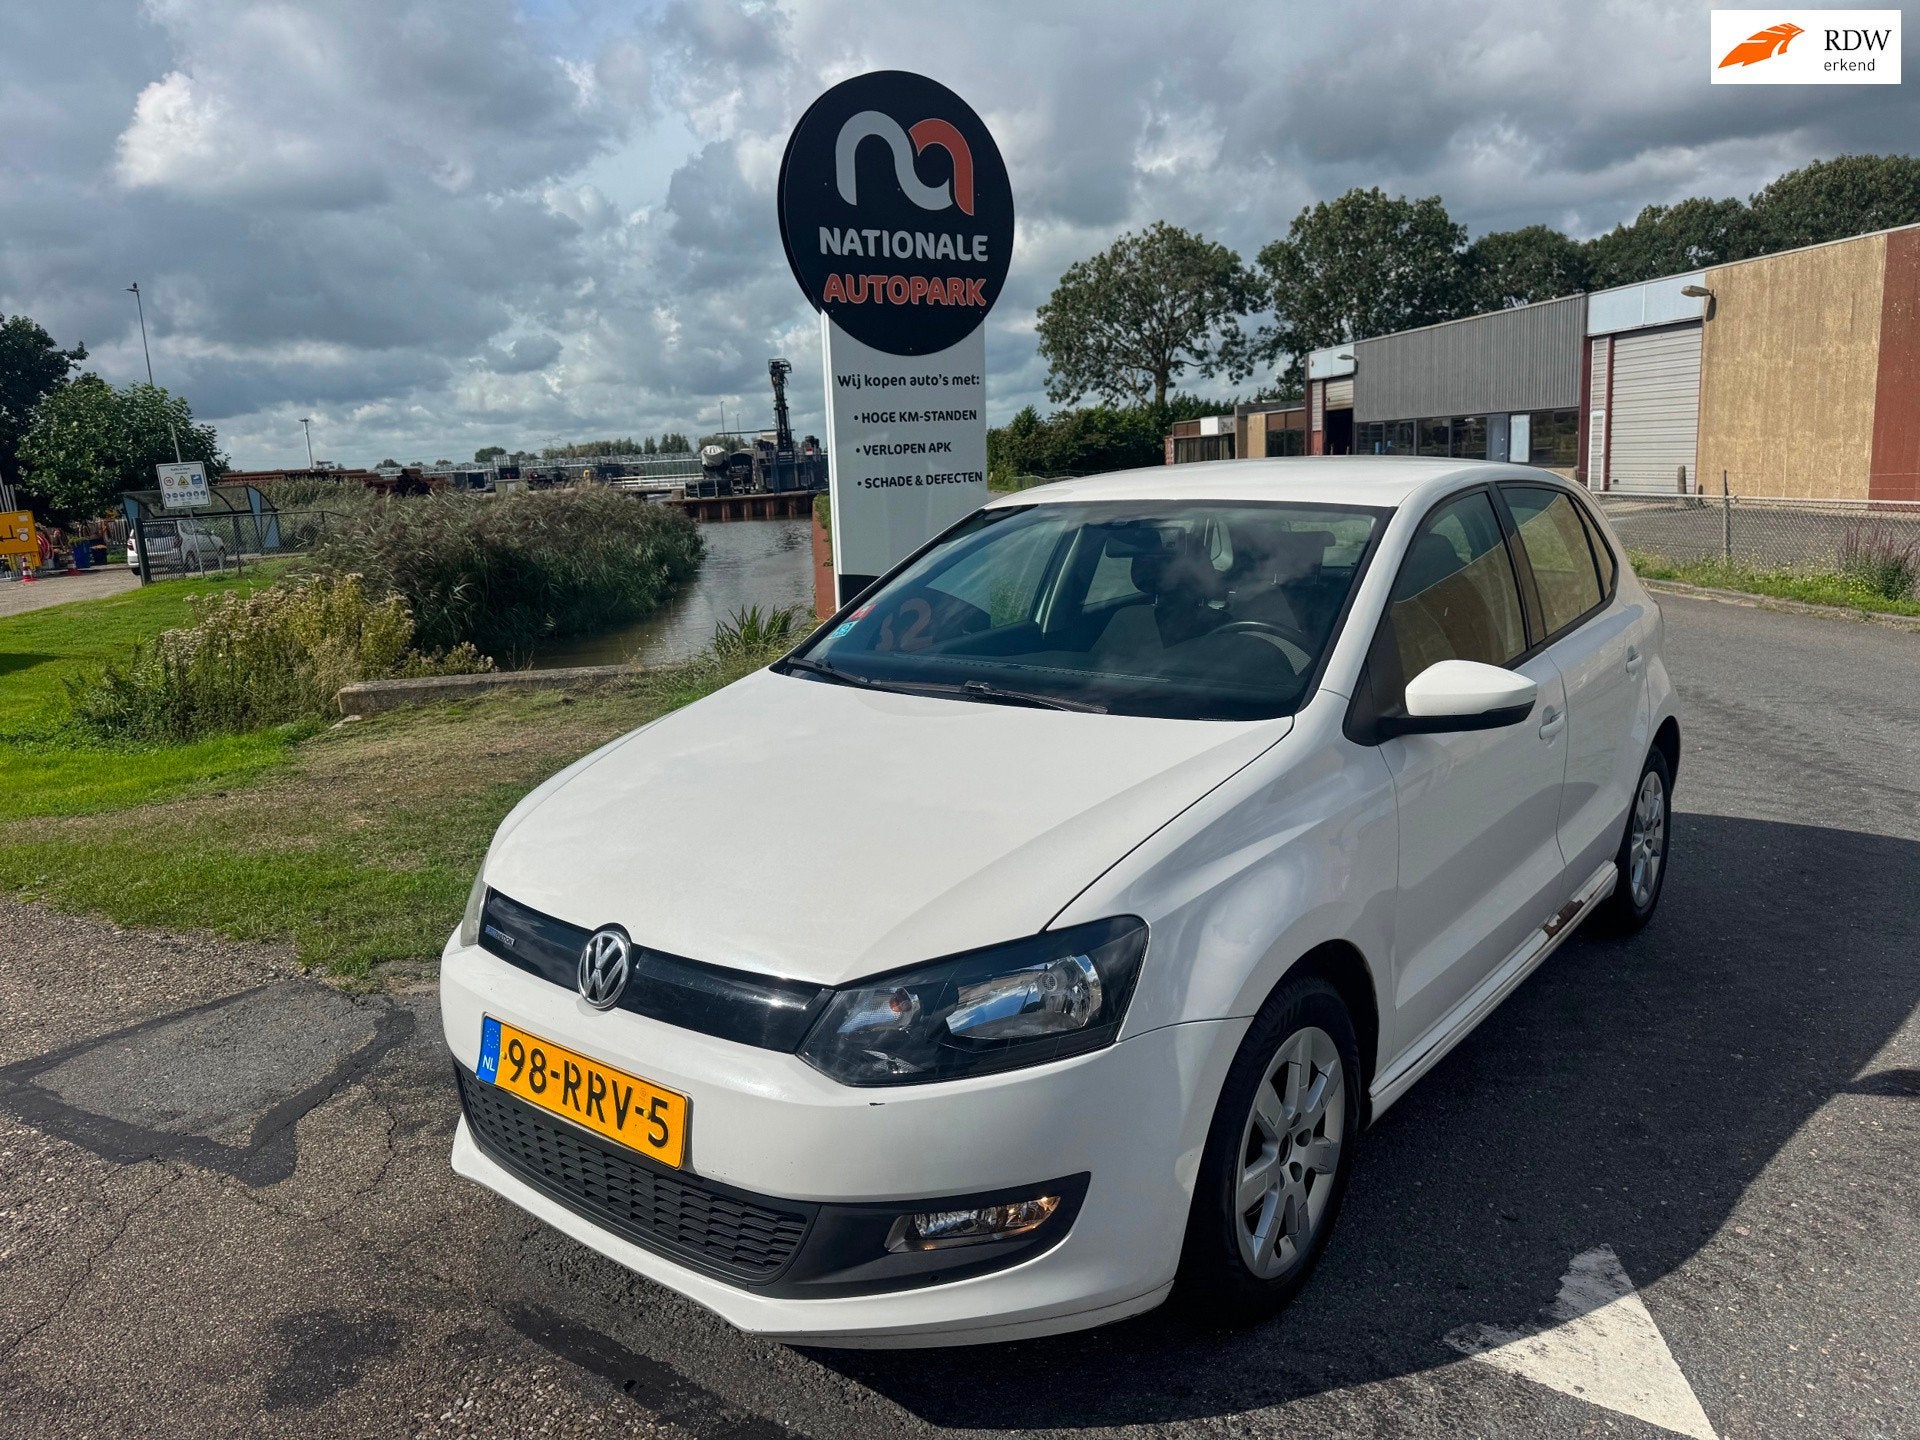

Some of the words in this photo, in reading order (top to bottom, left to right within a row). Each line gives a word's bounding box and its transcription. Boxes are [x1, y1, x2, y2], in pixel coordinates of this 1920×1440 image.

[818, 226, 988, 262] NATIONALE
[823, 273, 987, 306] AUTOPARK
[837, 374, 861, 389] Wij
[864, 375, 906, 388] kopen
[910, 374, 949, 386] auto's
[952, 374, 980, 386] met:
[861, 411, 896, 423] HOGE
[899, 410, 977, 422] KM-STANDEN
[863, 443, 926, 456] VERLOPEN
[928, 442, 952, 453] APK
[864, 475, 913, 489] SCHADE
[915, 475, 923, 486] &
[926, 471, 983, 486] DEFECTEN
[482, 1054, 496, 1073] NL
[507, 1037, 669, 1149] 98-RRV-5
